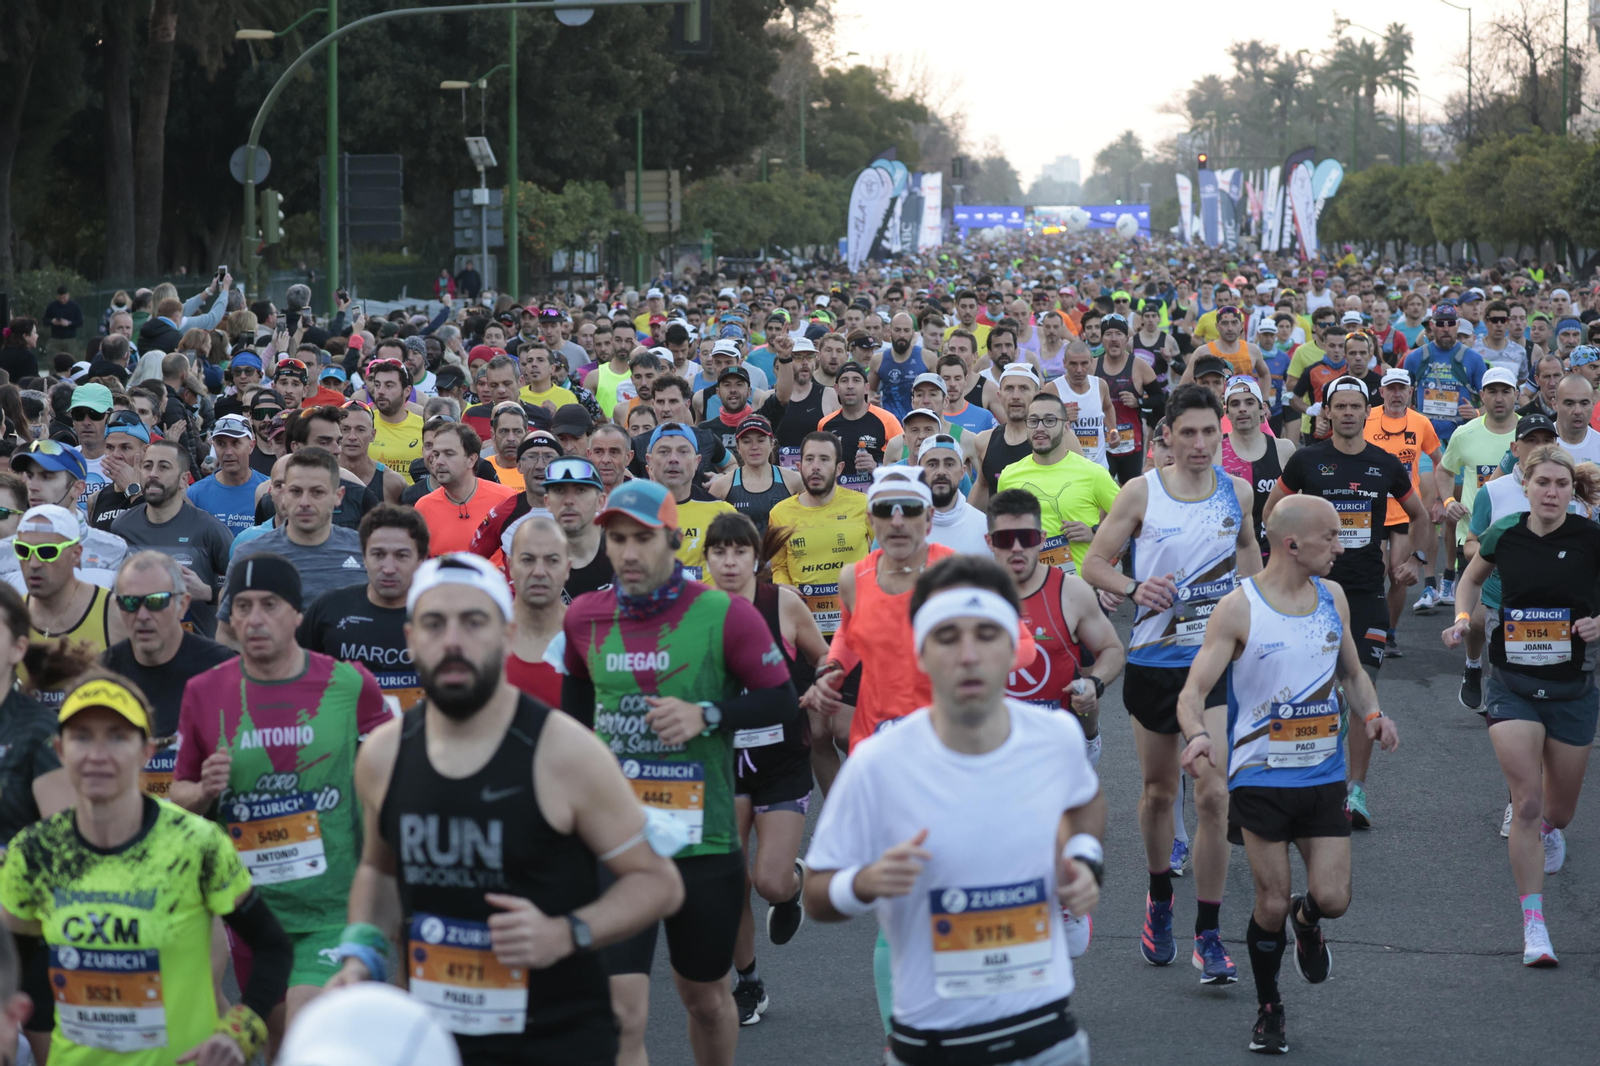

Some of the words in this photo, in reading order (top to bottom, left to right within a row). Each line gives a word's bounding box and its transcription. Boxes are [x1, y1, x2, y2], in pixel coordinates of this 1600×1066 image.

[847, 475, 872, 483] ZURICH
[1357, 489, 1379, 498] TIME
[831, 546, 854, 554] SEGOVIA
[1192, 582, 1228, 597] ZURICH
[816, 601, 834, 609] 4871
[1524, 610, 1562, 620] ZURICH
[1526, 628, 1549, 638] 5154
[1523, 643, 1553, 651] JOANNA
[605, 651, 670, 673] DIEGAO
[374, 674, 418, 687] ZURICH
[1295, 704, 1332, 716] ZURICH
[240, 725, 315, 749] ANTONIO
[1295, 726, 1318, 737] 3938
[1295, 742, 1316, 751] PACO
[642, 764, 694, 779] ZURICH
[642, 792, 673, 805] 4442
[252, 799, 304, 818] ZURICH
[258, 827, 290, 844] 5490
[399, 813, 504, 870] RUN
[255, 847, 299, 864] ANTONIO
[969, 886, 1038, 909] ZURICH
[63, 912, 141, 945] CXM
[82, 951, 147, 969] ZURICH
[443, 989, 486, 1006] PABLO
